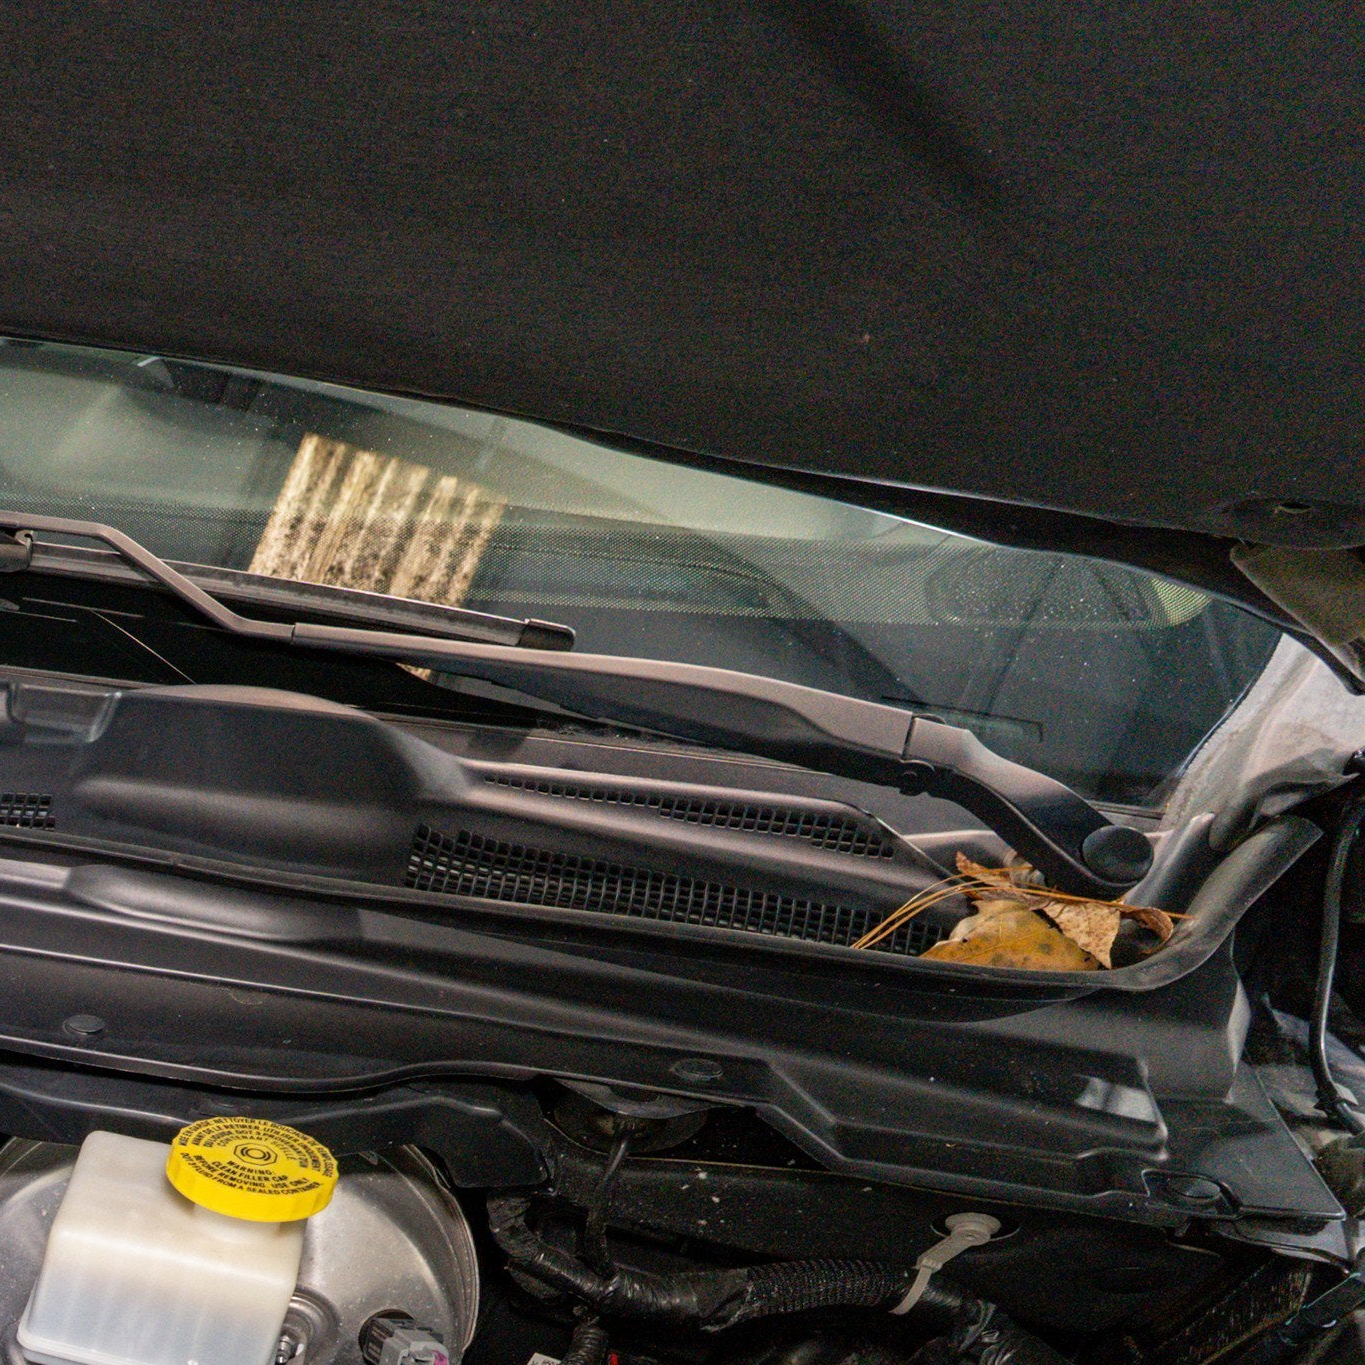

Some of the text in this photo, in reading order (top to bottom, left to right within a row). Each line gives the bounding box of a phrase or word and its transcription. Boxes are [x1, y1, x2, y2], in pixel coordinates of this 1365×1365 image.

[212, 1161, 237, 1175] CLEAN
[238, 1172, 270, 1181] FILLER
[212, 1176, 237, 1188] FROM
[246, 1187, 280, 1195] SEALED
